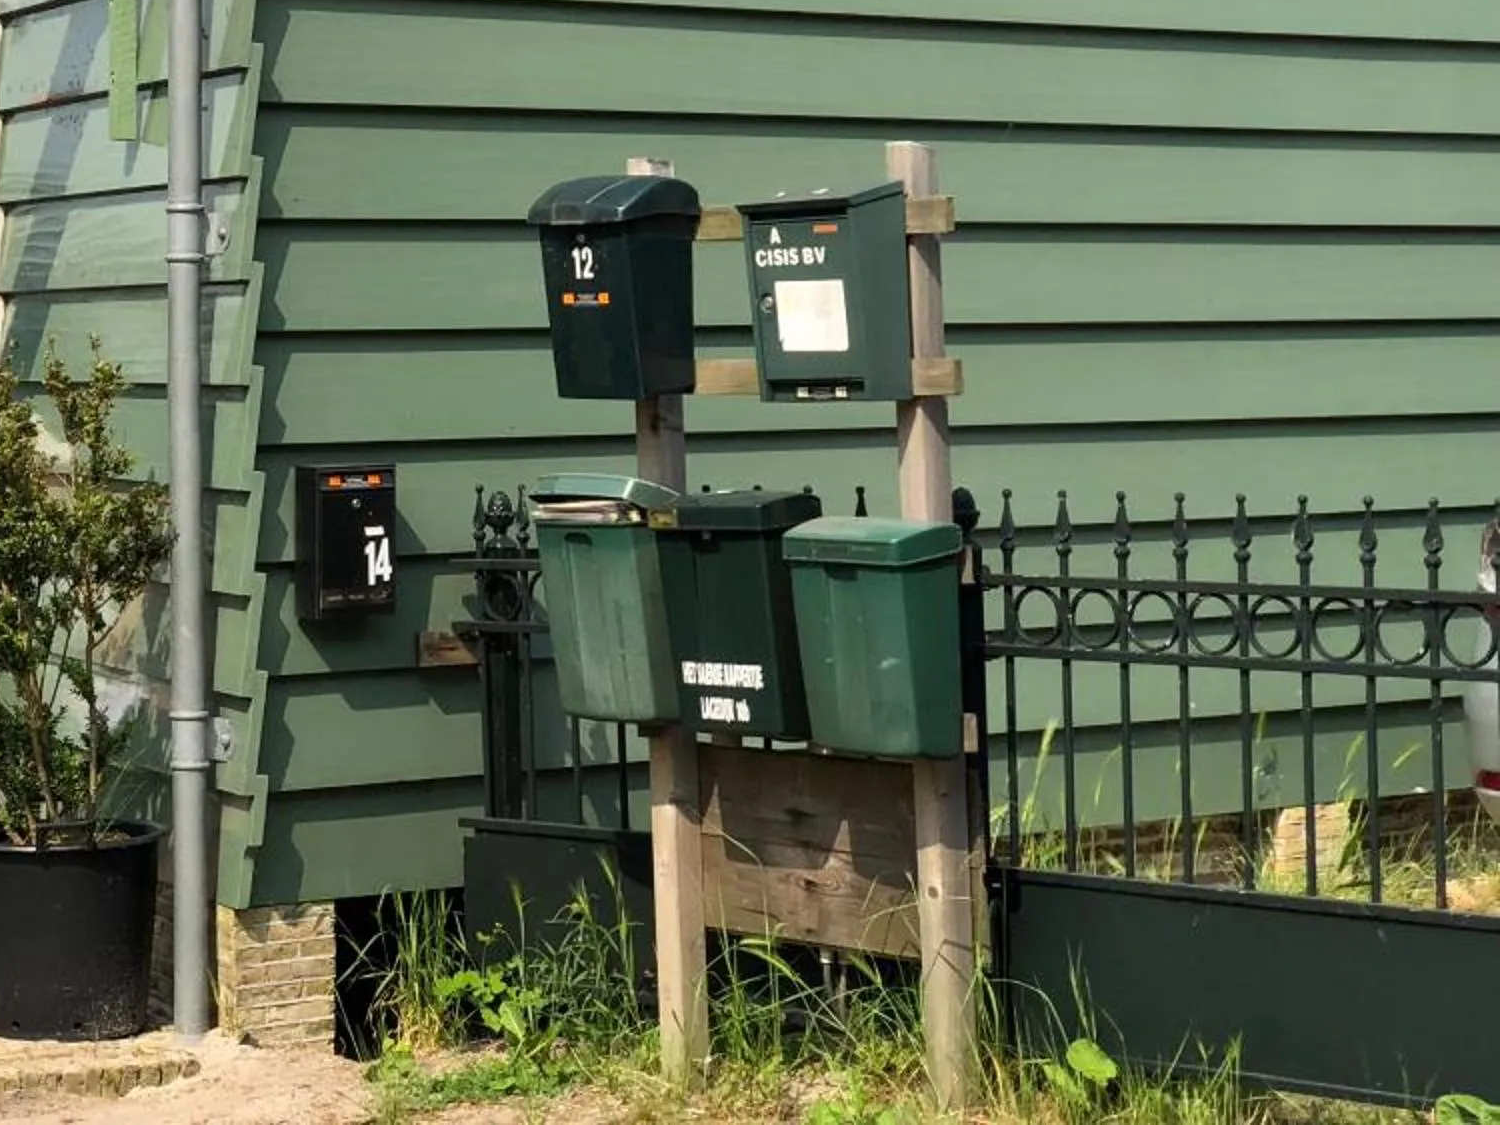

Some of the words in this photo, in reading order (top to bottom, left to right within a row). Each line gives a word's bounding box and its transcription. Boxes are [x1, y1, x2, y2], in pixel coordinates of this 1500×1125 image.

[770, 226, 781, 244] A
[571, 246, 595, 280] 12
[755, 247, 799, 268] CISIS
[802, 246, 826, 265] BV
[364, 536, 393, 587] 14
